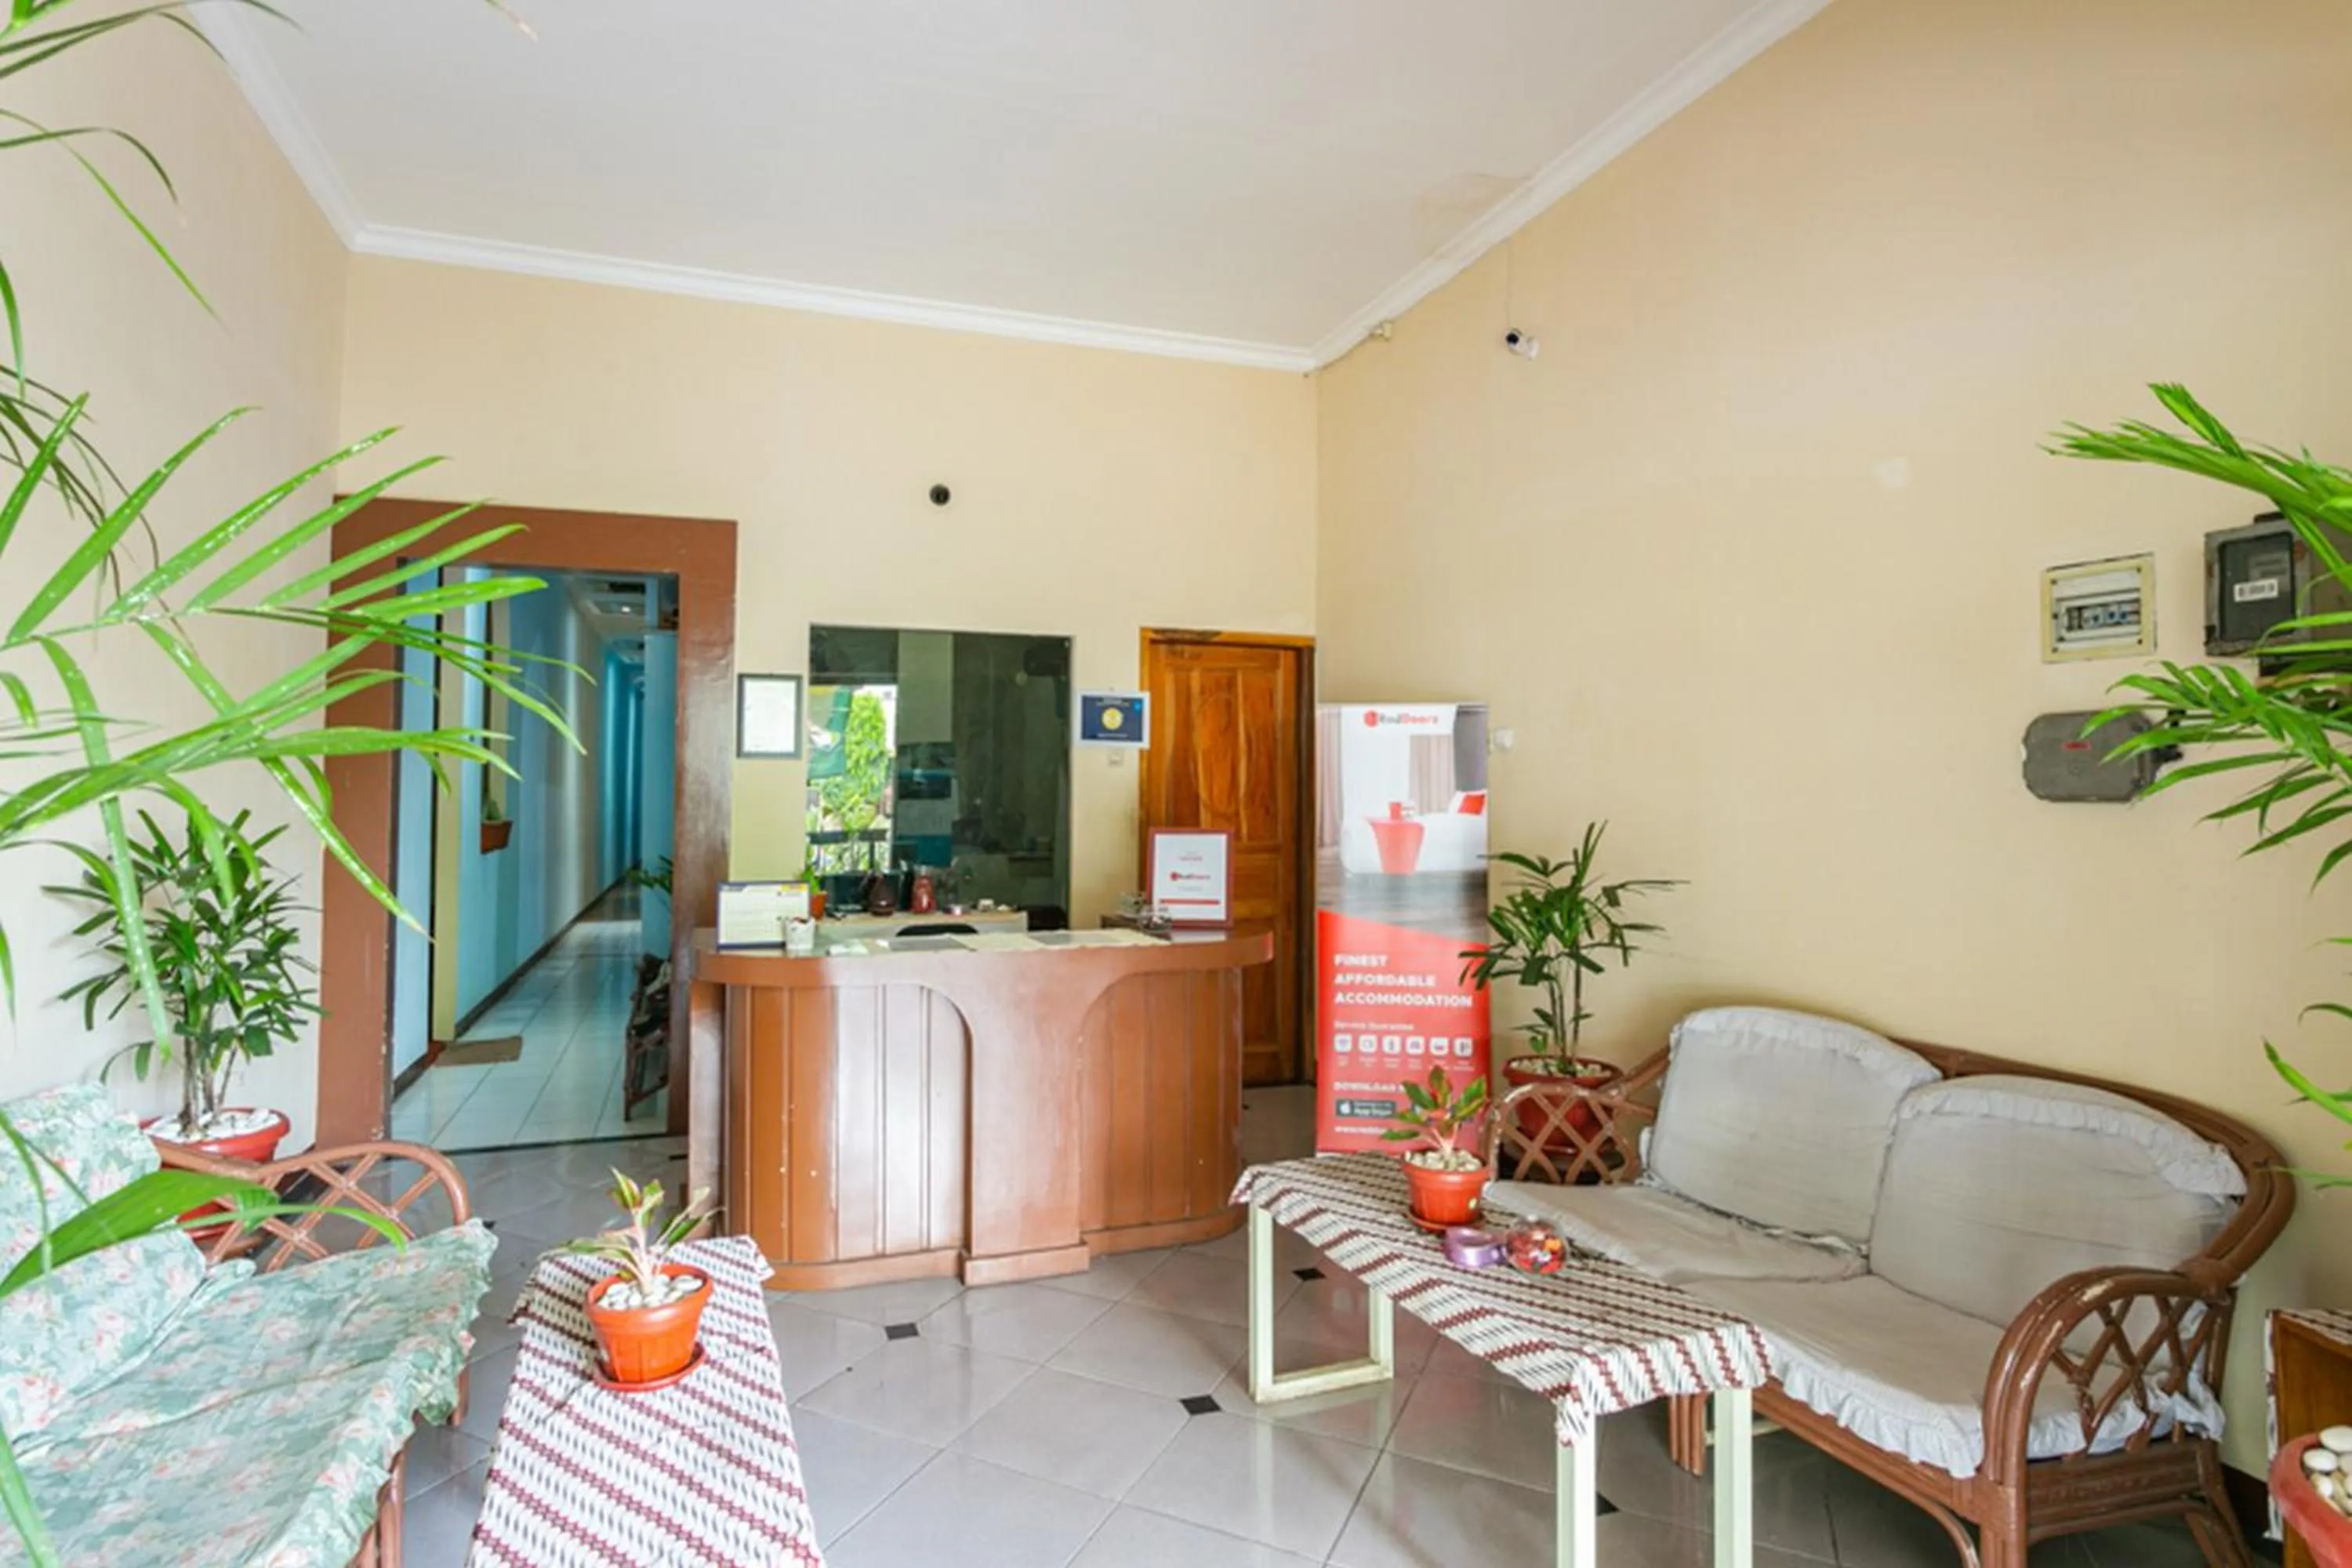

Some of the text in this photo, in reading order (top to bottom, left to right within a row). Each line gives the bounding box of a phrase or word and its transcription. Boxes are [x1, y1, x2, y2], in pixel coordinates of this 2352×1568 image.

[1334, 953, 1388, 967] FINEST
[1334, 974, 1436, 987] AFFORDABLE
[1334, 993, 1472, 1007] ACCOMMODATION
